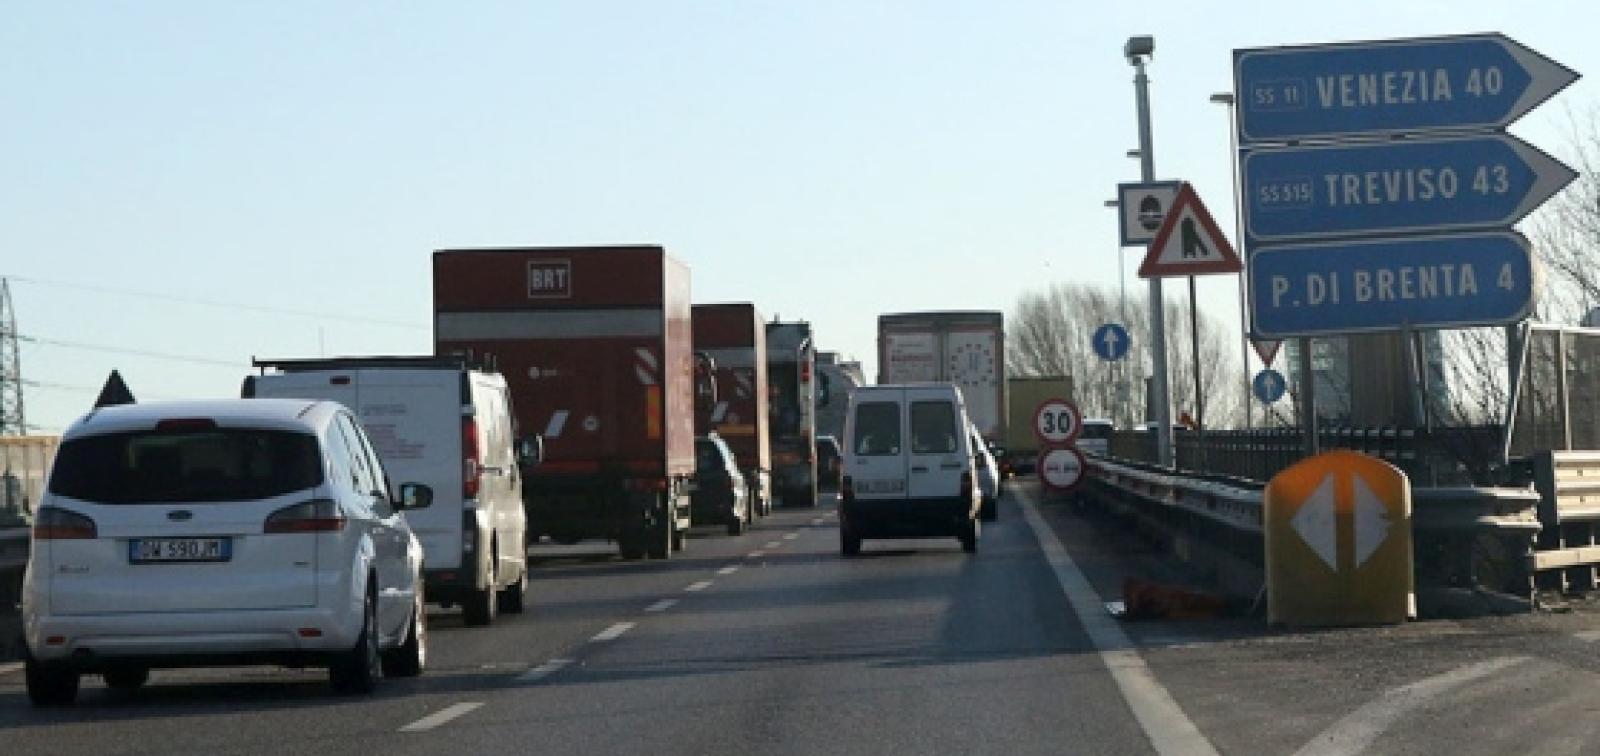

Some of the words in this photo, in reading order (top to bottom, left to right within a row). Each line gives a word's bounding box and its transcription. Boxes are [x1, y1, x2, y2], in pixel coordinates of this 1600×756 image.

[1256, 88, 1274, 104] SS
[1316, 69, 1451, 108] VENEZIA
[1466, 67, 1503, 96] 40
[1324, 168, 1458, 207] TREVISO
[1472, 165, 1509, 195] 43
[532, 268, 566, 289] BRT
[1355, 264, 1478, 302] BRENTA
[1496, 263, 1515, 291] 4
[1043, 410, 1070, 433] 30
